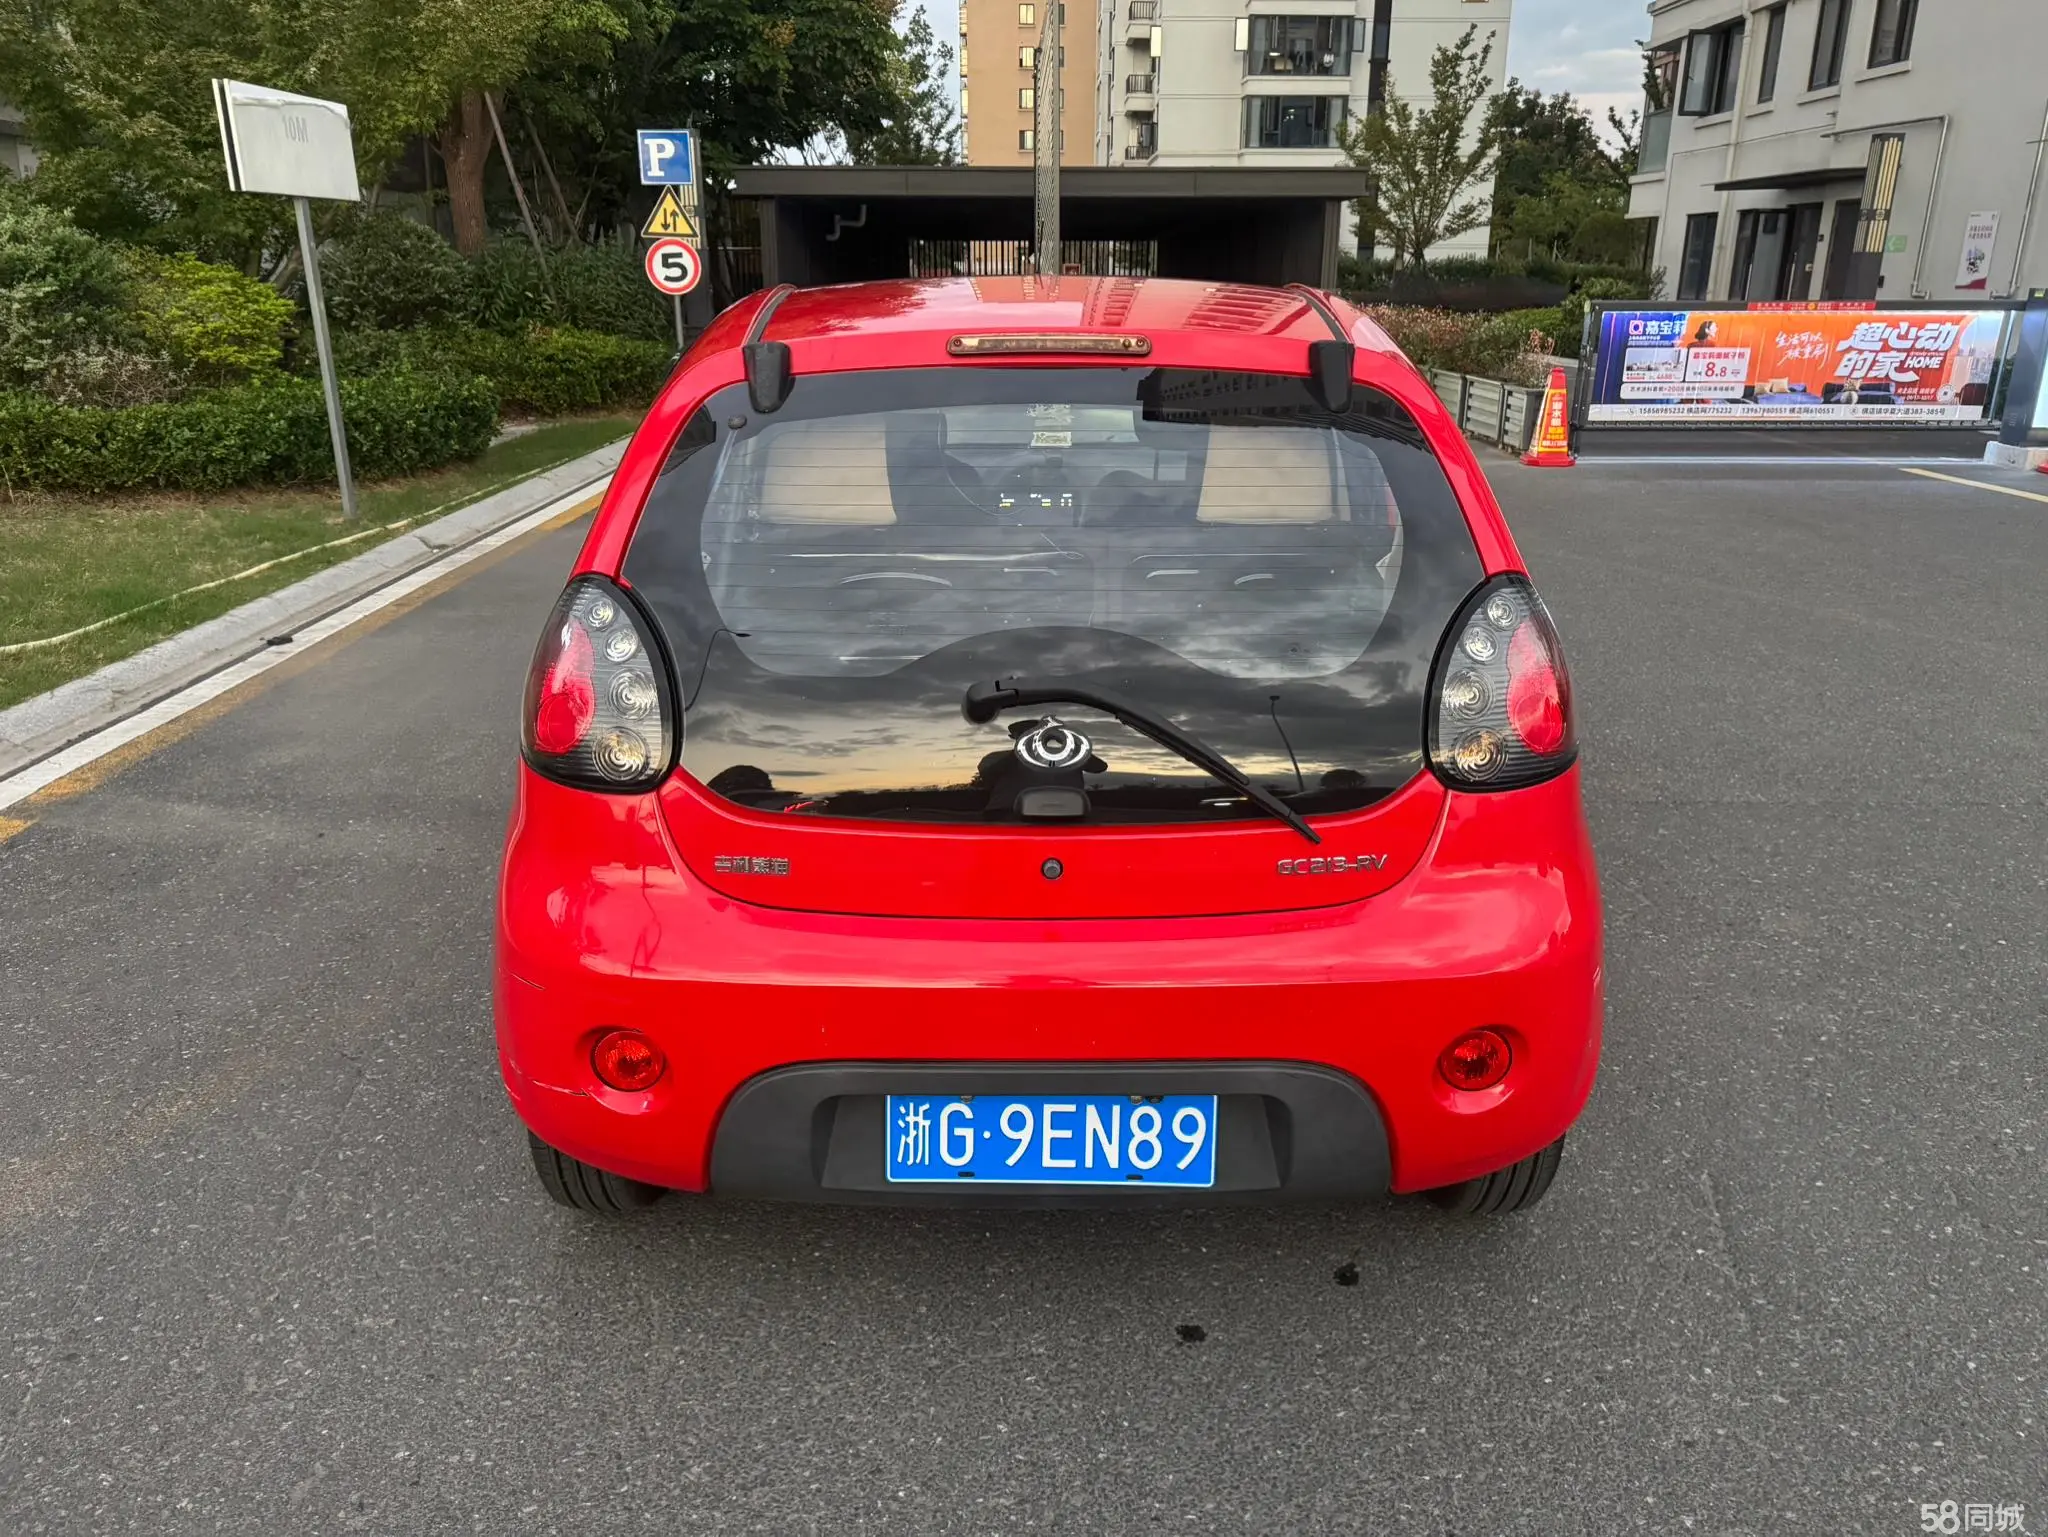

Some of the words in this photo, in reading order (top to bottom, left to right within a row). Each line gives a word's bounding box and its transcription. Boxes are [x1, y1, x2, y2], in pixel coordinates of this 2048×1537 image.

[644, 138, 675, 176] P
[661, 252, 688, 282] 5
[1836, 322, 1959, 351] 超心动
[1705, 362, 1727, 377] 8.8
[1834, 353, 1919, 382] 的家
[1904, 357, 1944, 369] HOME
[897, 1102, 1206, 1170] 浙G·9EN89
